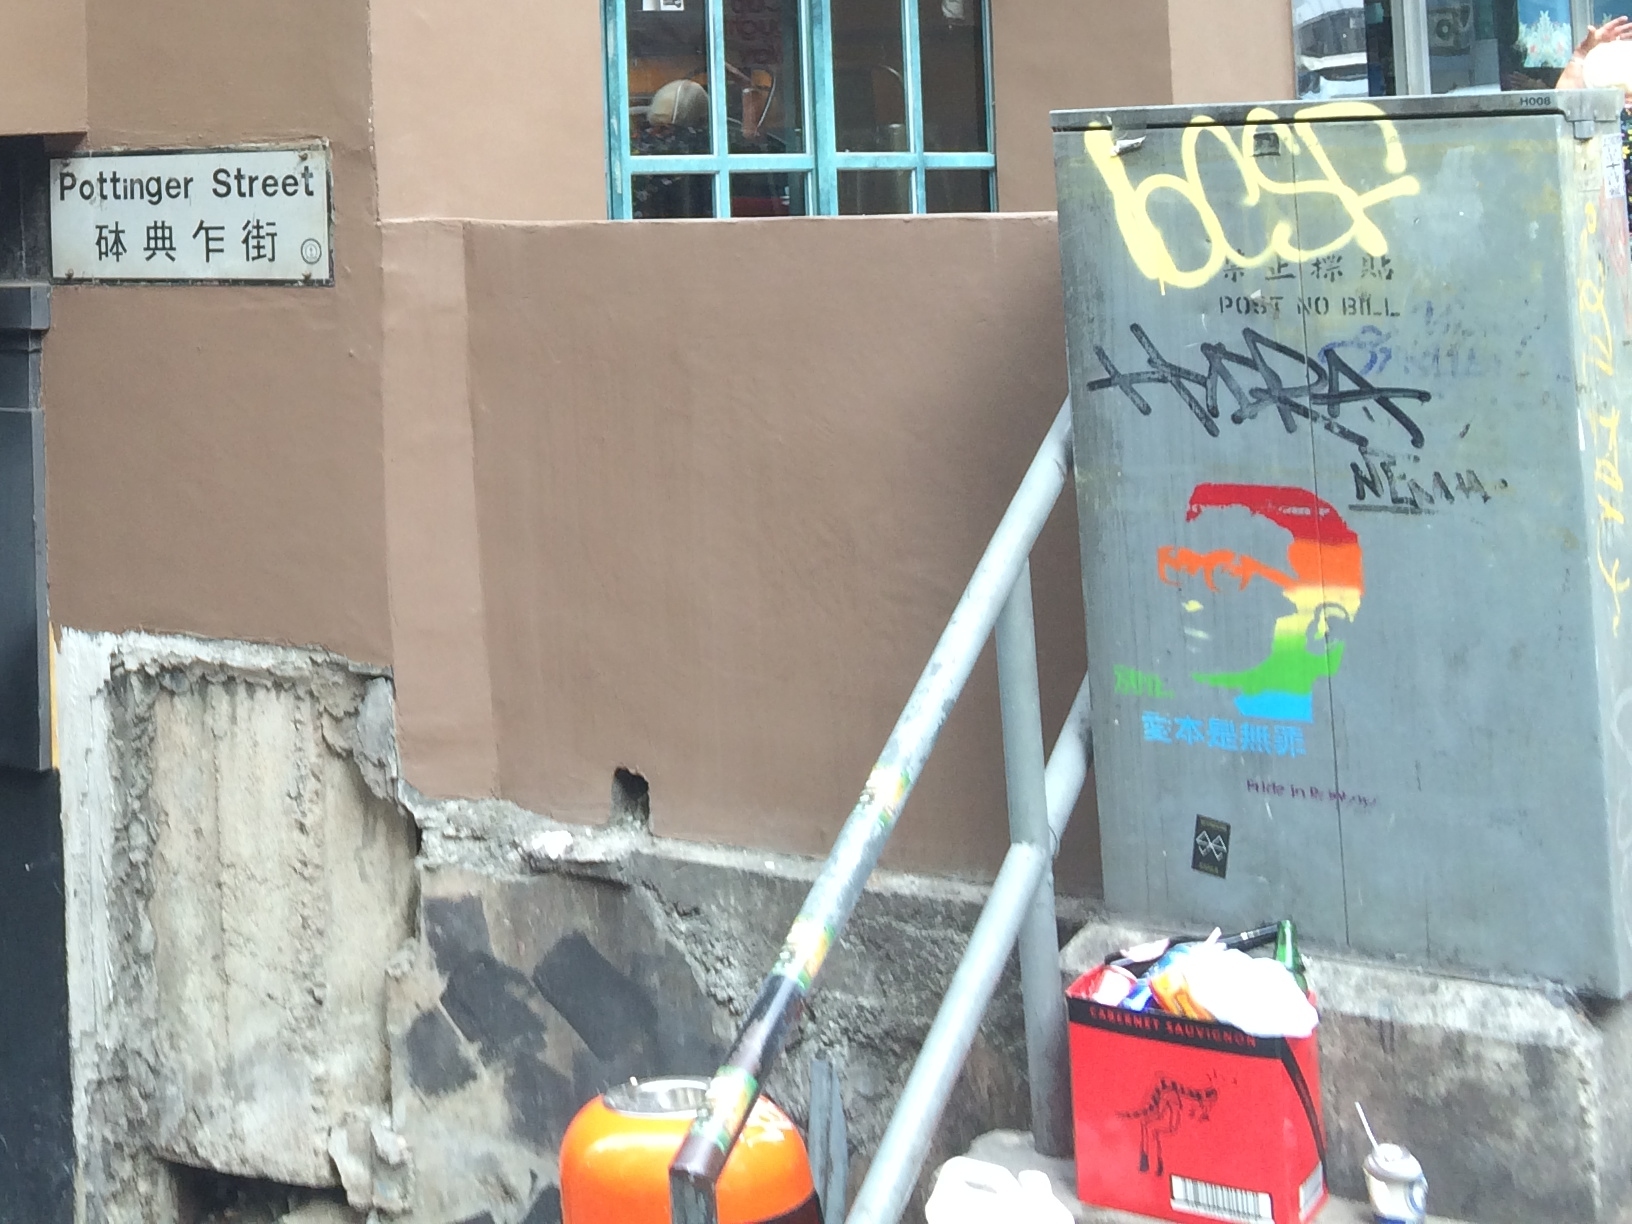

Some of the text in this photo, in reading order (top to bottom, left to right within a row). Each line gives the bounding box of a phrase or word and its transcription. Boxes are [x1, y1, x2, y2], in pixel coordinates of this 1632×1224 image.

[58, 165, 315, 205] Pottinger Street
[95, 218, 278, 263] 砵典乍街
[1219, 295, 1401, 317] POST NO BILL
[1089, 1006, 1257, 1048] CABERNET SAUVIGNON
